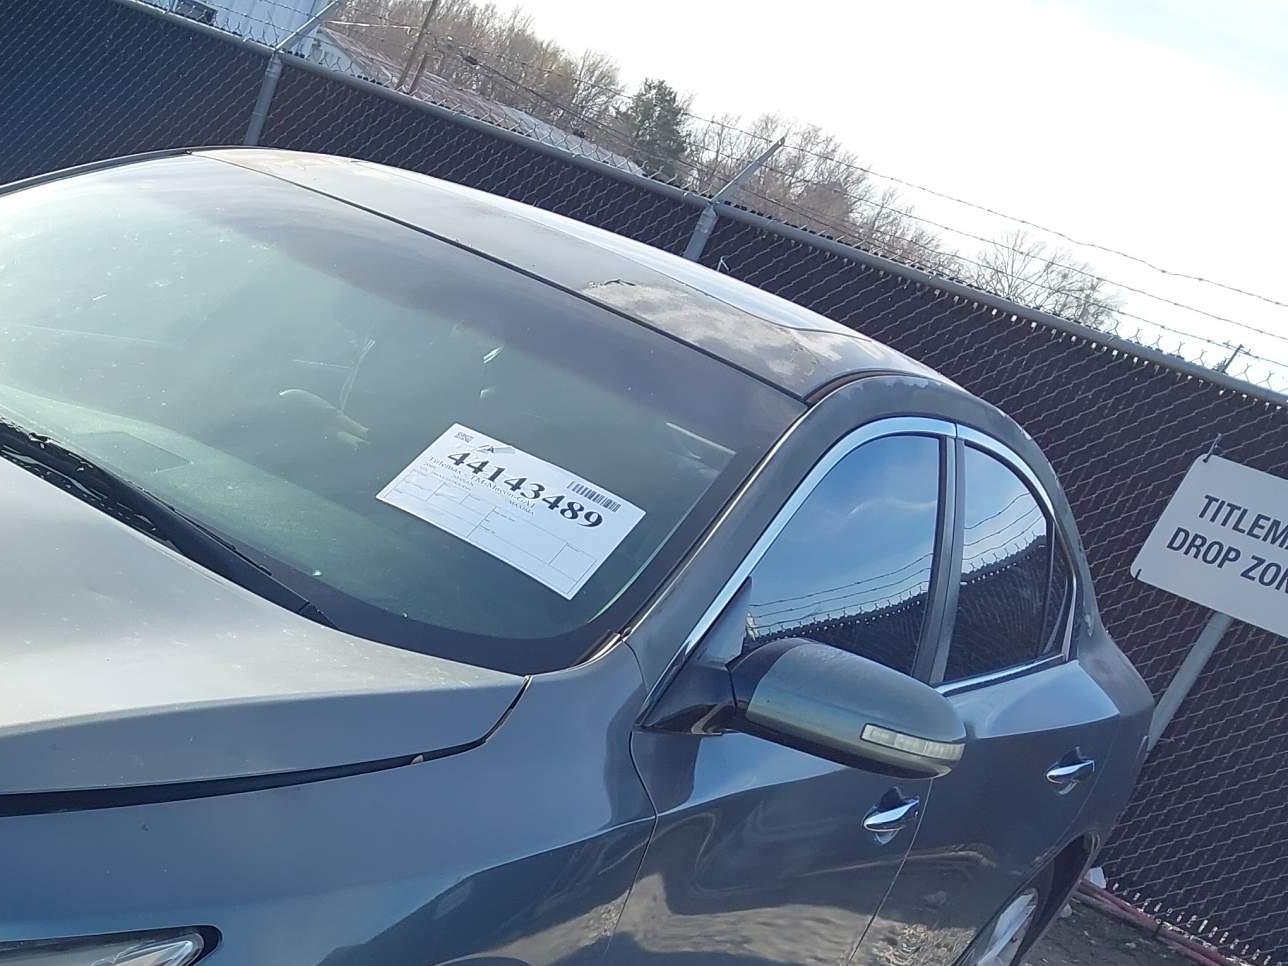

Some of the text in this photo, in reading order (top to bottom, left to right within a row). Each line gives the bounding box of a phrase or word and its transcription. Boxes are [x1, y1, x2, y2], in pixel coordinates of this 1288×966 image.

[447, 452, 603, 528] 44143489
[1166, 526, 1241, 569] DROP
[1198, 494, 1288, 550] TITLEM
